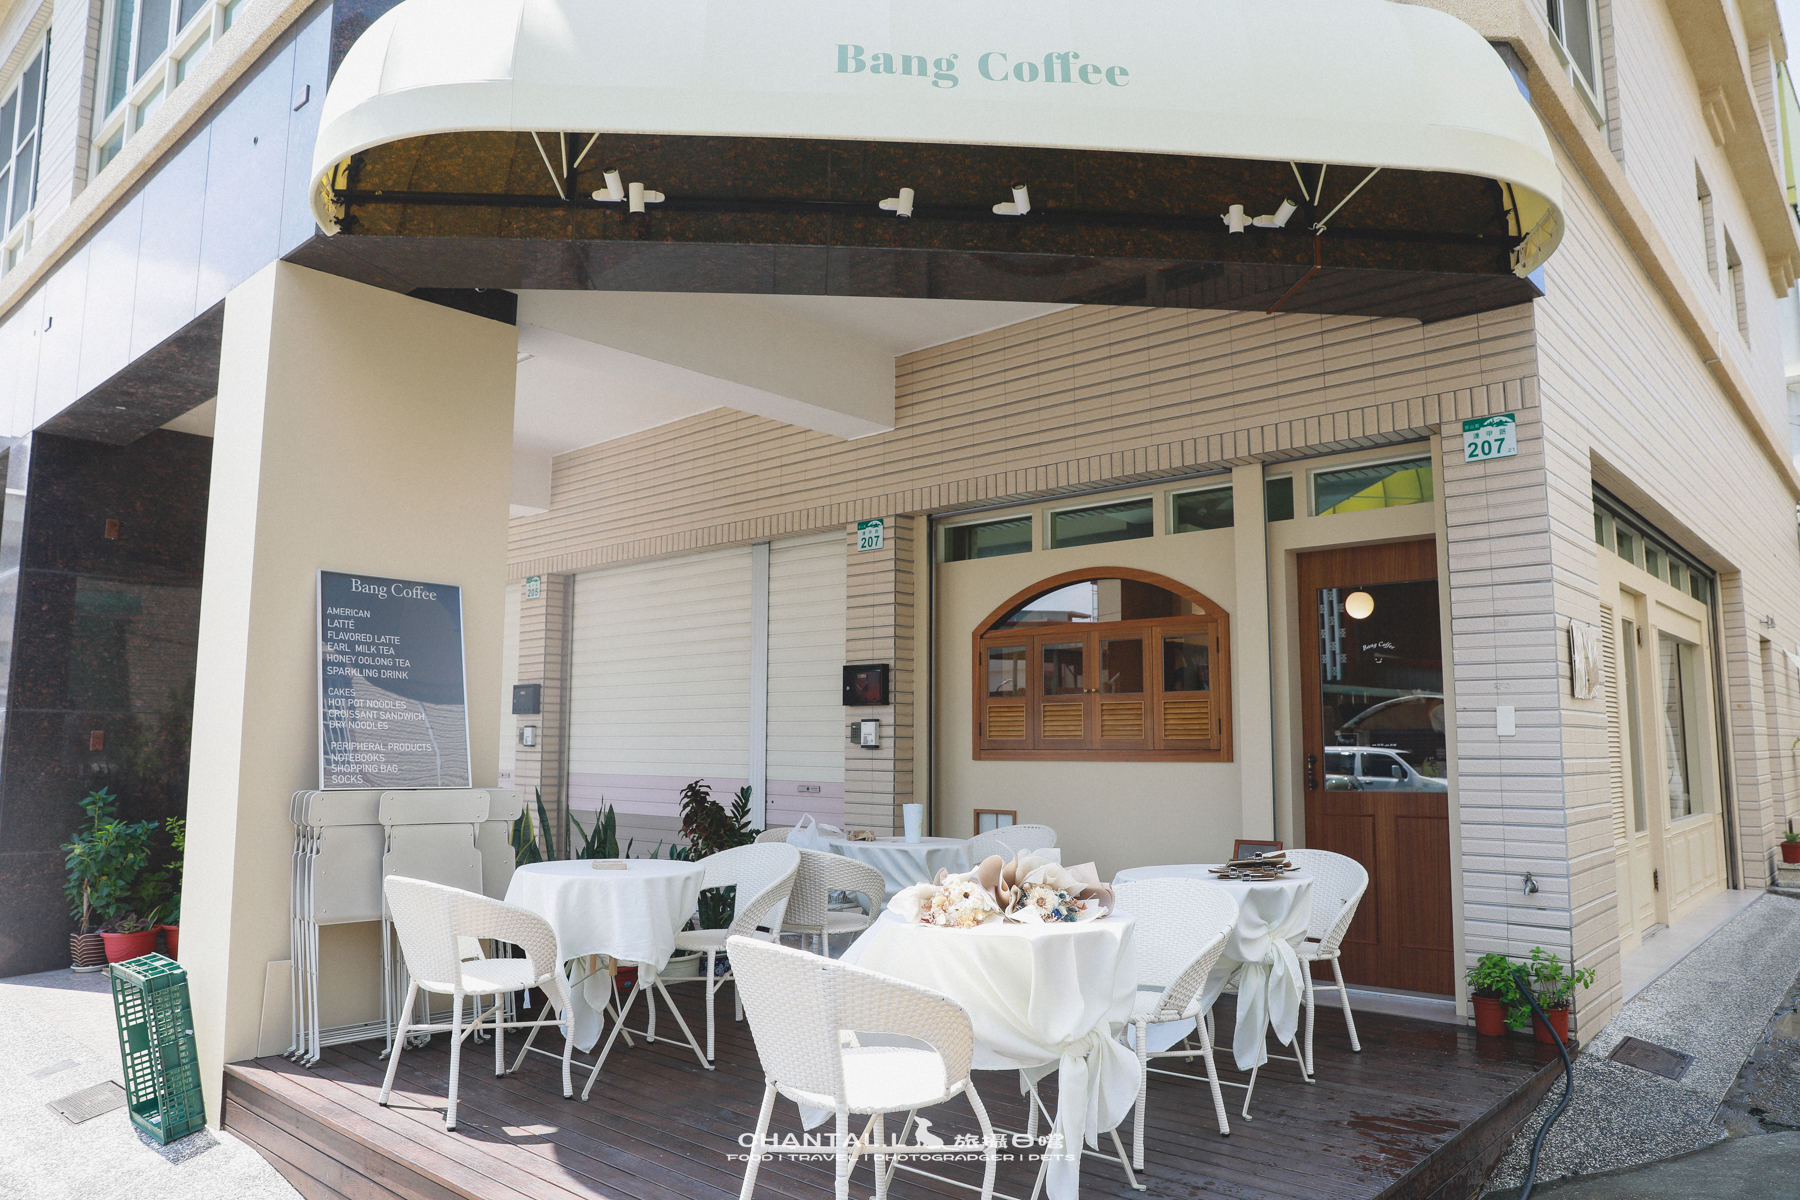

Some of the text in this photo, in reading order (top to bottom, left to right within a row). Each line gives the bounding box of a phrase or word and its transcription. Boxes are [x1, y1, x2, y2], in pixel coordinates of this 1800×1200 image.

[834, 43, 1130, 89] Bang Coffee
[1468, 438, 1505, 458] 207
[861, 536, 880, 548] 207
[351, 578, 437, 600] Bang Coffee
[528, 588, 538, 598] 205
[326, 606, 371, 618] AMERICAN
[327, 631, 401, 645] FLAVORED LATTE
[327, 642, 396, 656] EARL MILK TEA
[1378, 641, 1396, 650] Coffee
[326, 653, 411, 668] HONEY OOLONG TEA
[326, 666, 409, 680] SPARKLING DRINK
[328, 687, 356, 697] CAKES
[328, 698, 407, 709] HOT POT NOODLES
[328, 709, 426, 721] CROISSANT SANDWICH
[329, 720, 389, 730] DRY NOODLES
[330, 741, 432, 752] PERIPHERAL PRODUCTS
[331, 753, 386, 762] NOTEBOOKS
[331, 764, 399, 773] SHOPPING BAG
[331, 774, 364, 784] SOCKS
